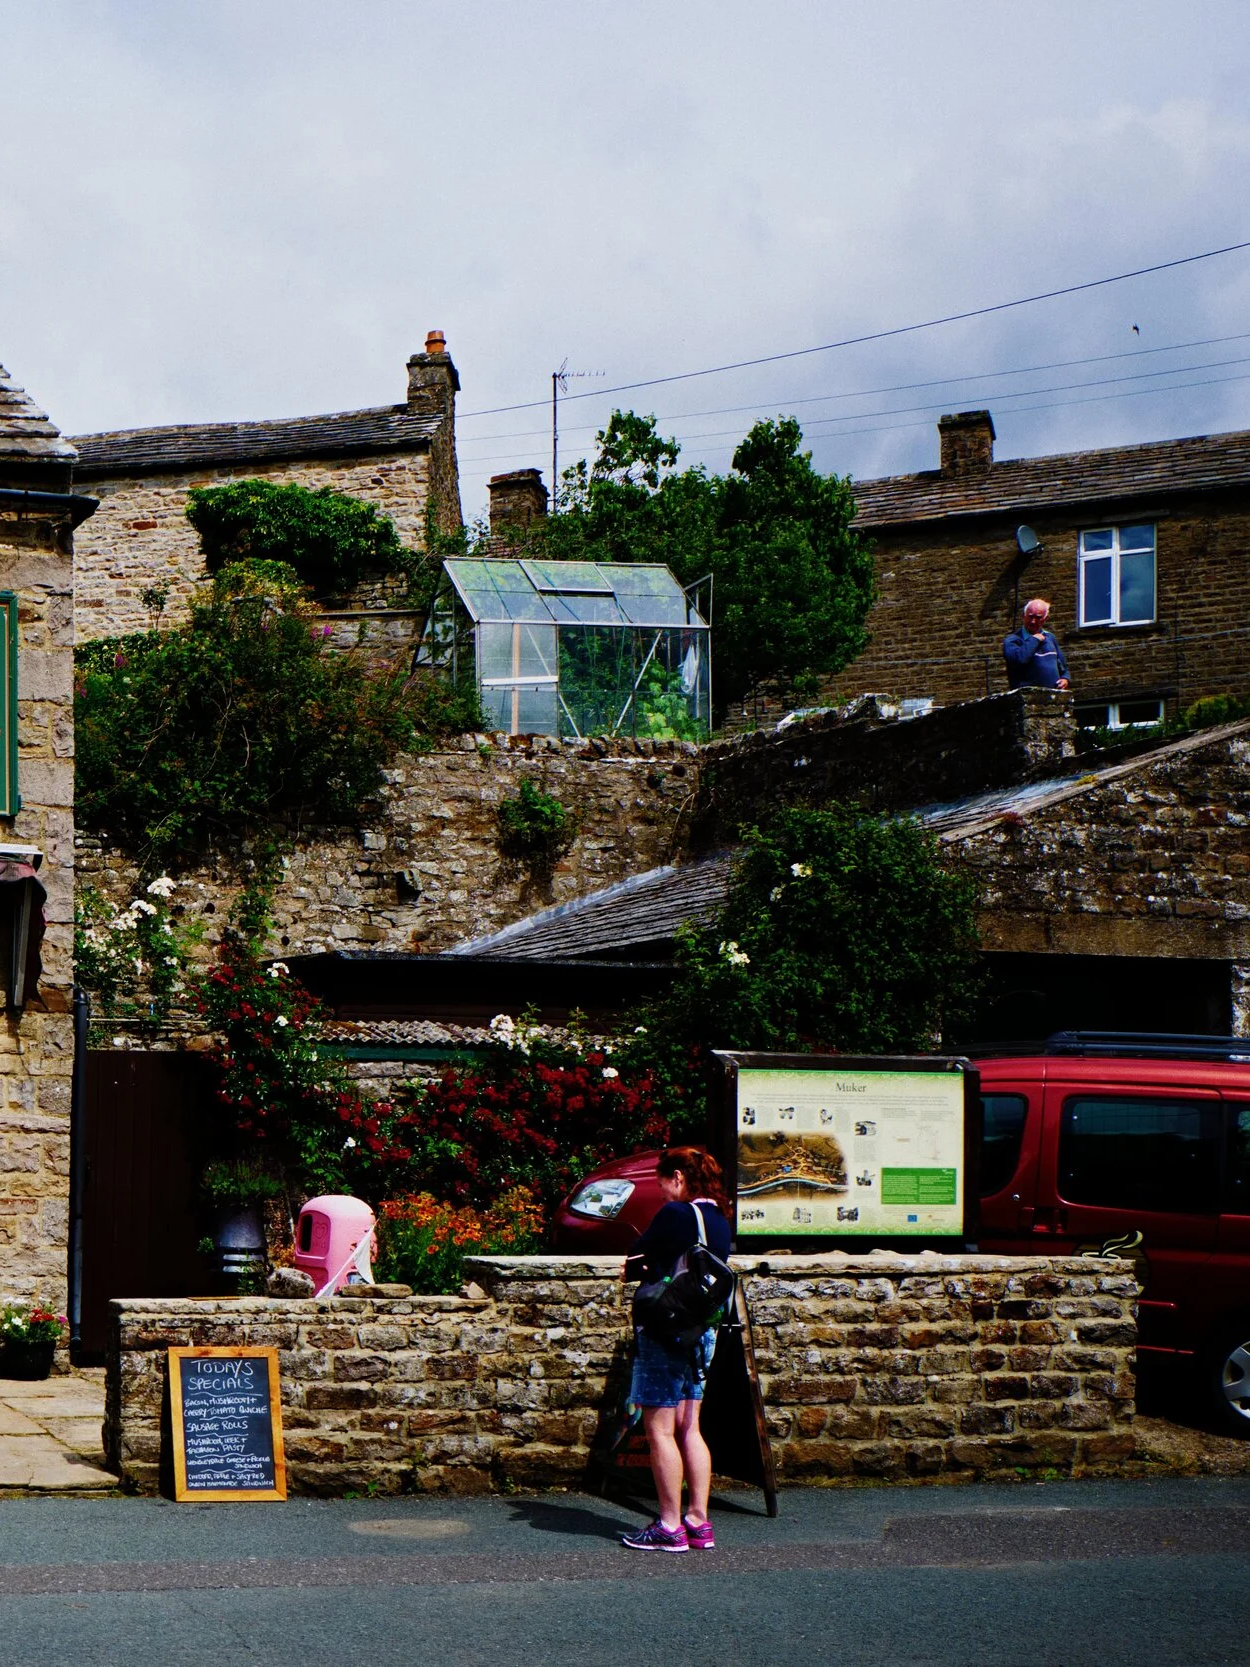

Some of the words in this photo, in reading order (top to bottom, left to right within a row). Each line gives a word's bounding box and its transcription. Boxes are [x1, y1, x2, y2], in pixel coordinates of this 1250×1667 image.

[836, 1082, 867, 1093] Muker
[191, 1359, 254, 1378] TODAYS
[187, 1377, 254, 1390] SPECIALS
[184, 1408, 207, 1418] CHERRY
[207, 1407, 236, 1415] TOMATO
[239, 1405, 268, 1414] QUICHE
[186, 1422, 220, 1433] SAUSAGE
[221, 1420, 248, 1430] ROLLS
[222, 1444, 245, 1453] PASTY
